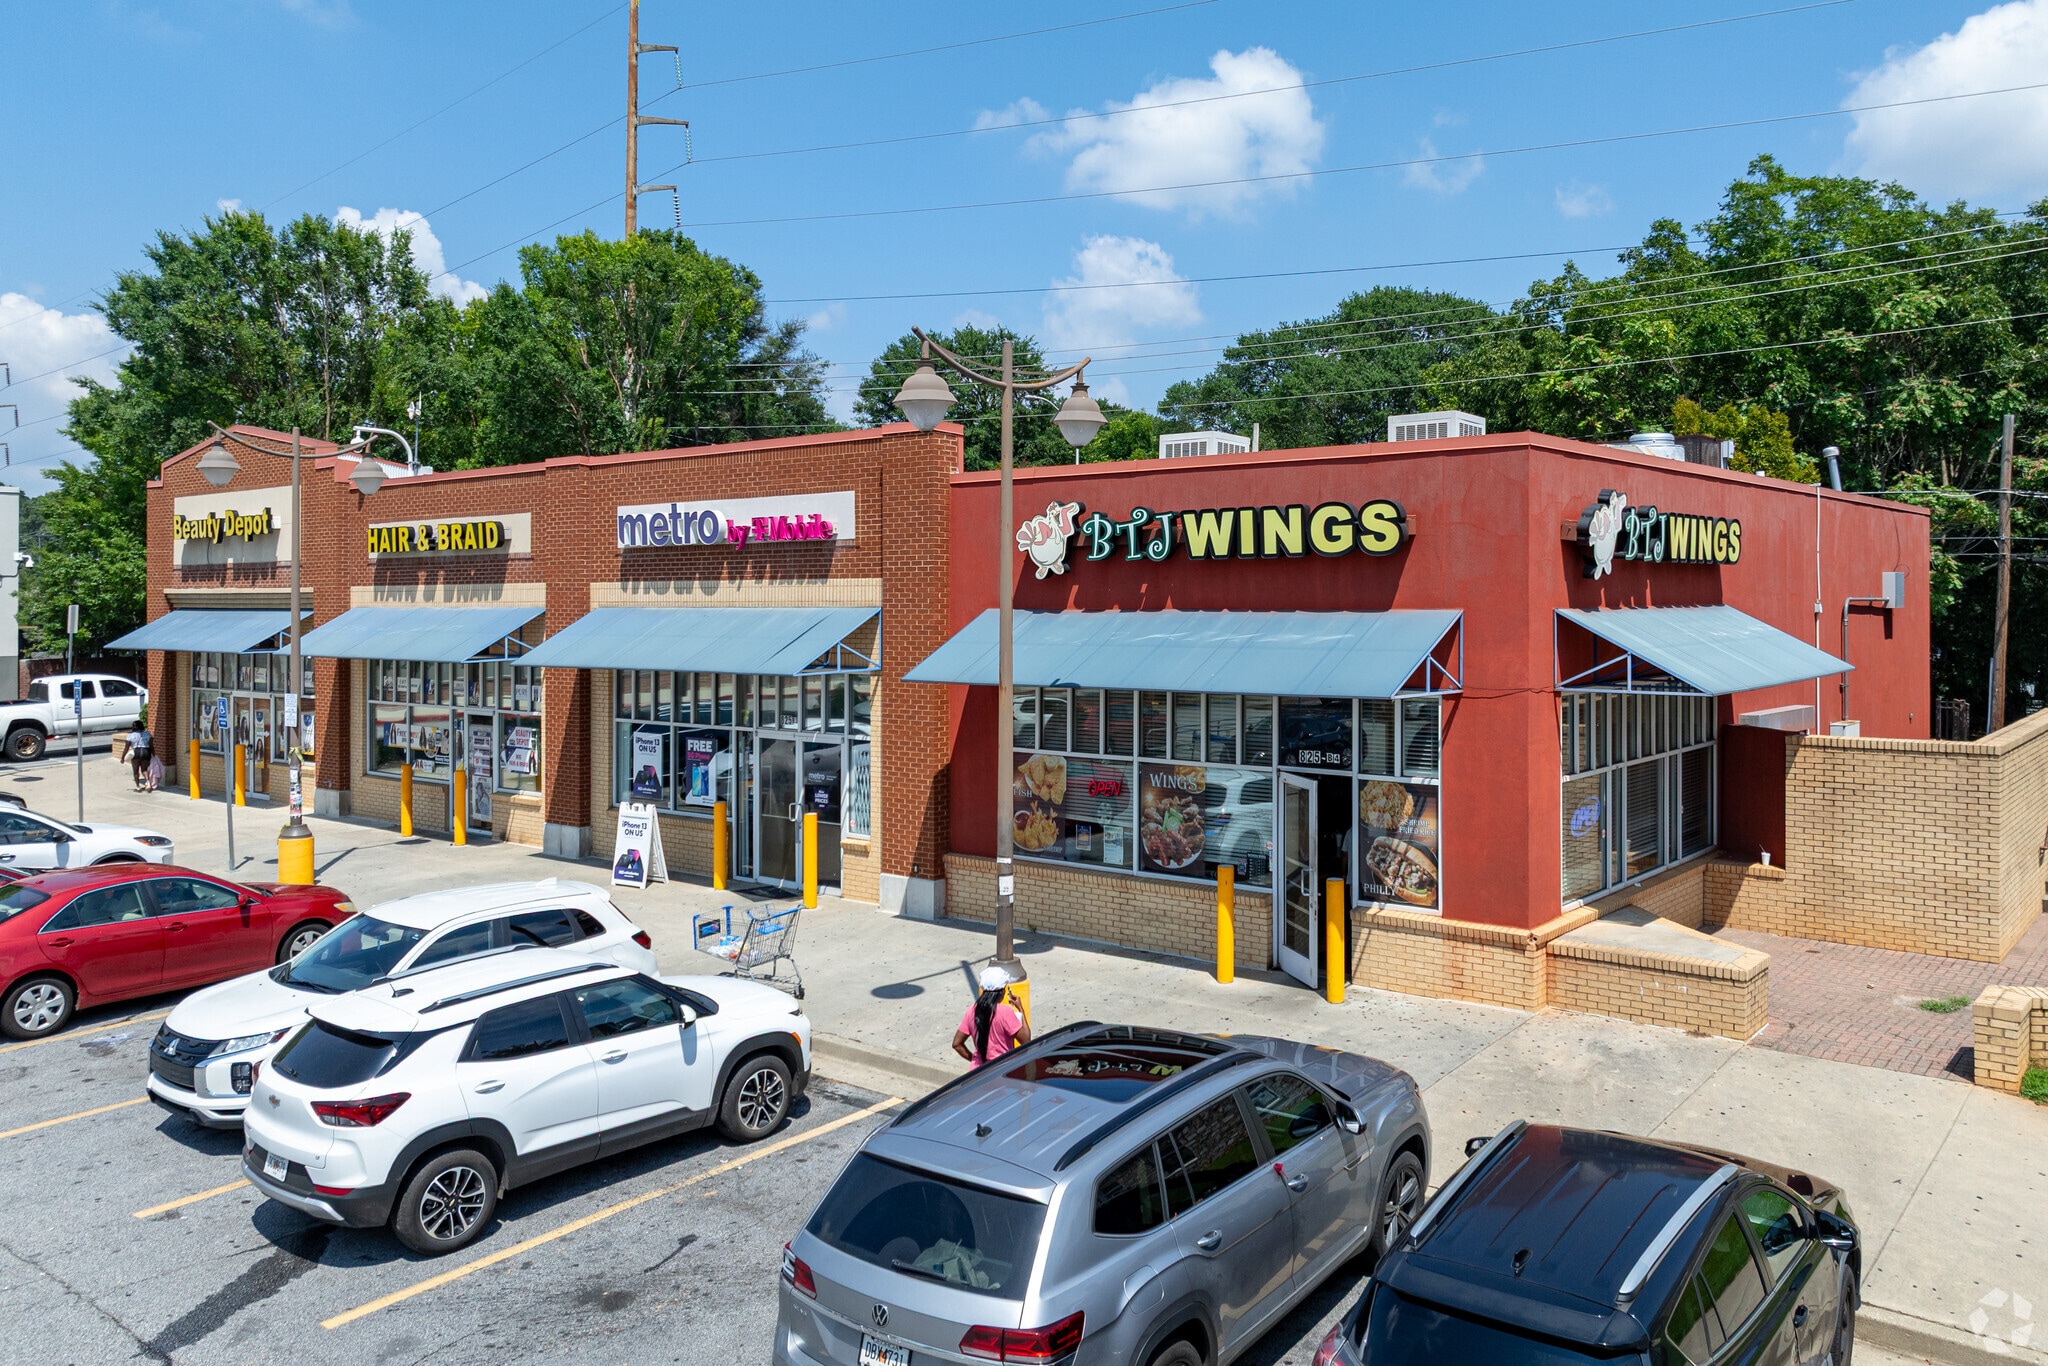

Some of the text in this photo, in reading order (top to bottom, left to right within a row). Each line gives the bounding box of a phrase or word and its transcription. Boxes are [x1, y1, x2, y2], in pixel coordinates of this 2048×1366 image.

[173, 507, 271, 544] Beauty Depot
[618, 503, 722, 547] metro
[726, 519, 750, 550] by
[1081, 501, 1403, 561] BTJ WINGS
[367, 521, 501, 553] HAIR & BRAID
[1625, 505, 1741, 564] BTJ WINGS
[635, 736, 660, 746] iPhone 13
[687, 739, 713, 752] FREE
[1087, 780, 1122, 797] OPEN
[1149, 771, 1198, 791] WINGS
[1013, 789, 1033, 798] FISH
[622, 821, 640, 829] iPhone
[1404, 819, 1430, 827] SHRIMP
[634, 829, 643, 837] US
[1363, 883, 1396, 896] PHILLY
